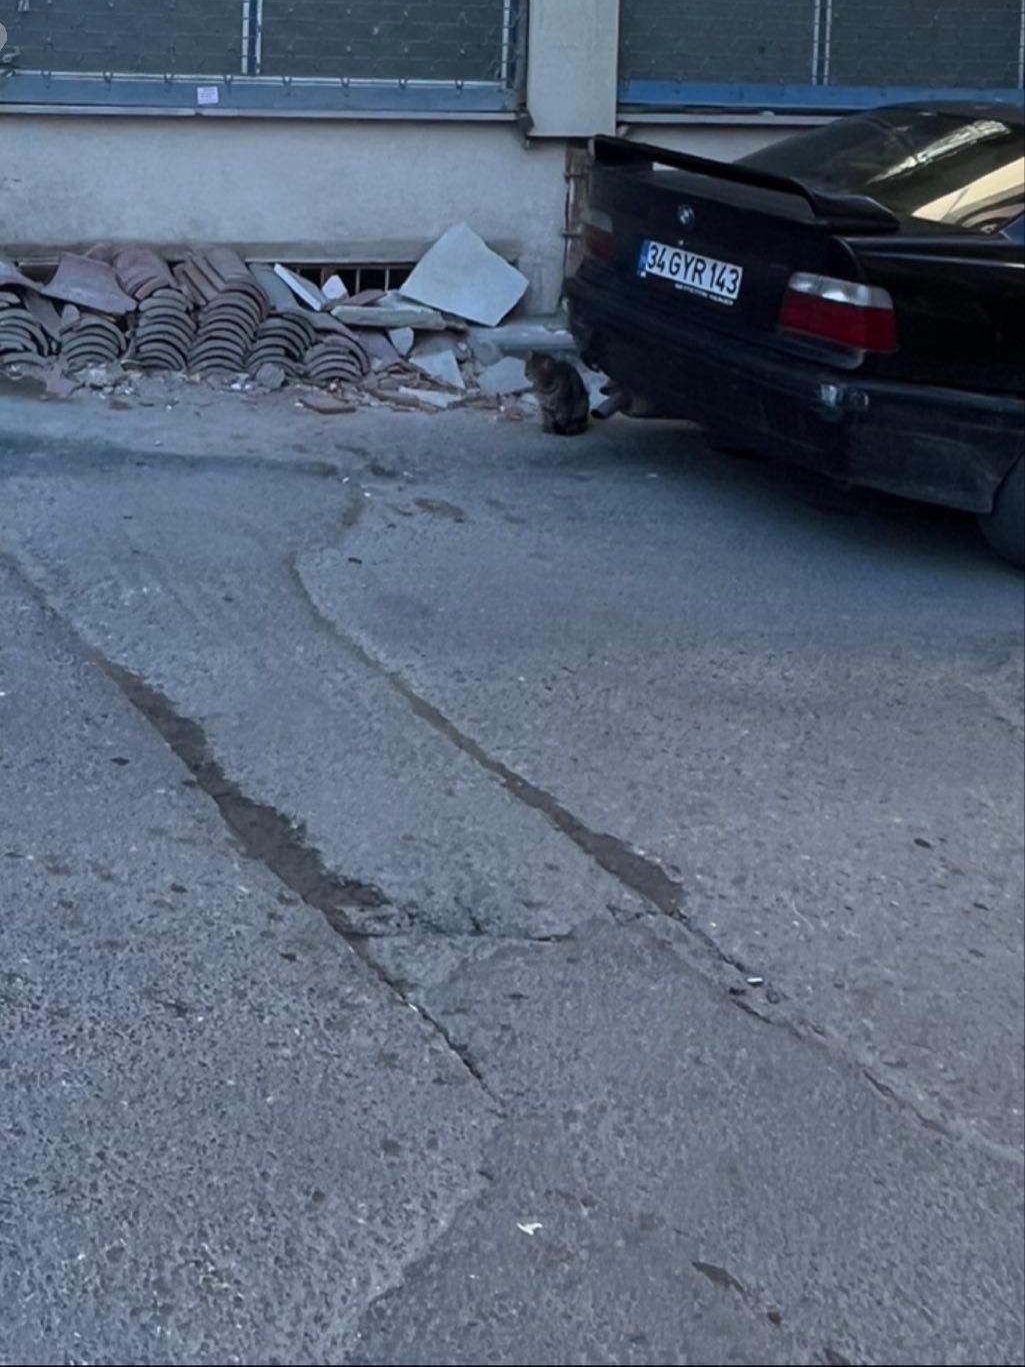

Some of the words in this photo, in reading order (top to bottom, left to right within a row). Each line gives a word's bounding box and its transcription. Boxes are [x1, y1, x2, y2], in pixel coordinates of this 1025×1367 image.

[647, 244, 666, 273] 34
[669, 251, 707, 286] GYR
[709, 262, 739, 295] 143
